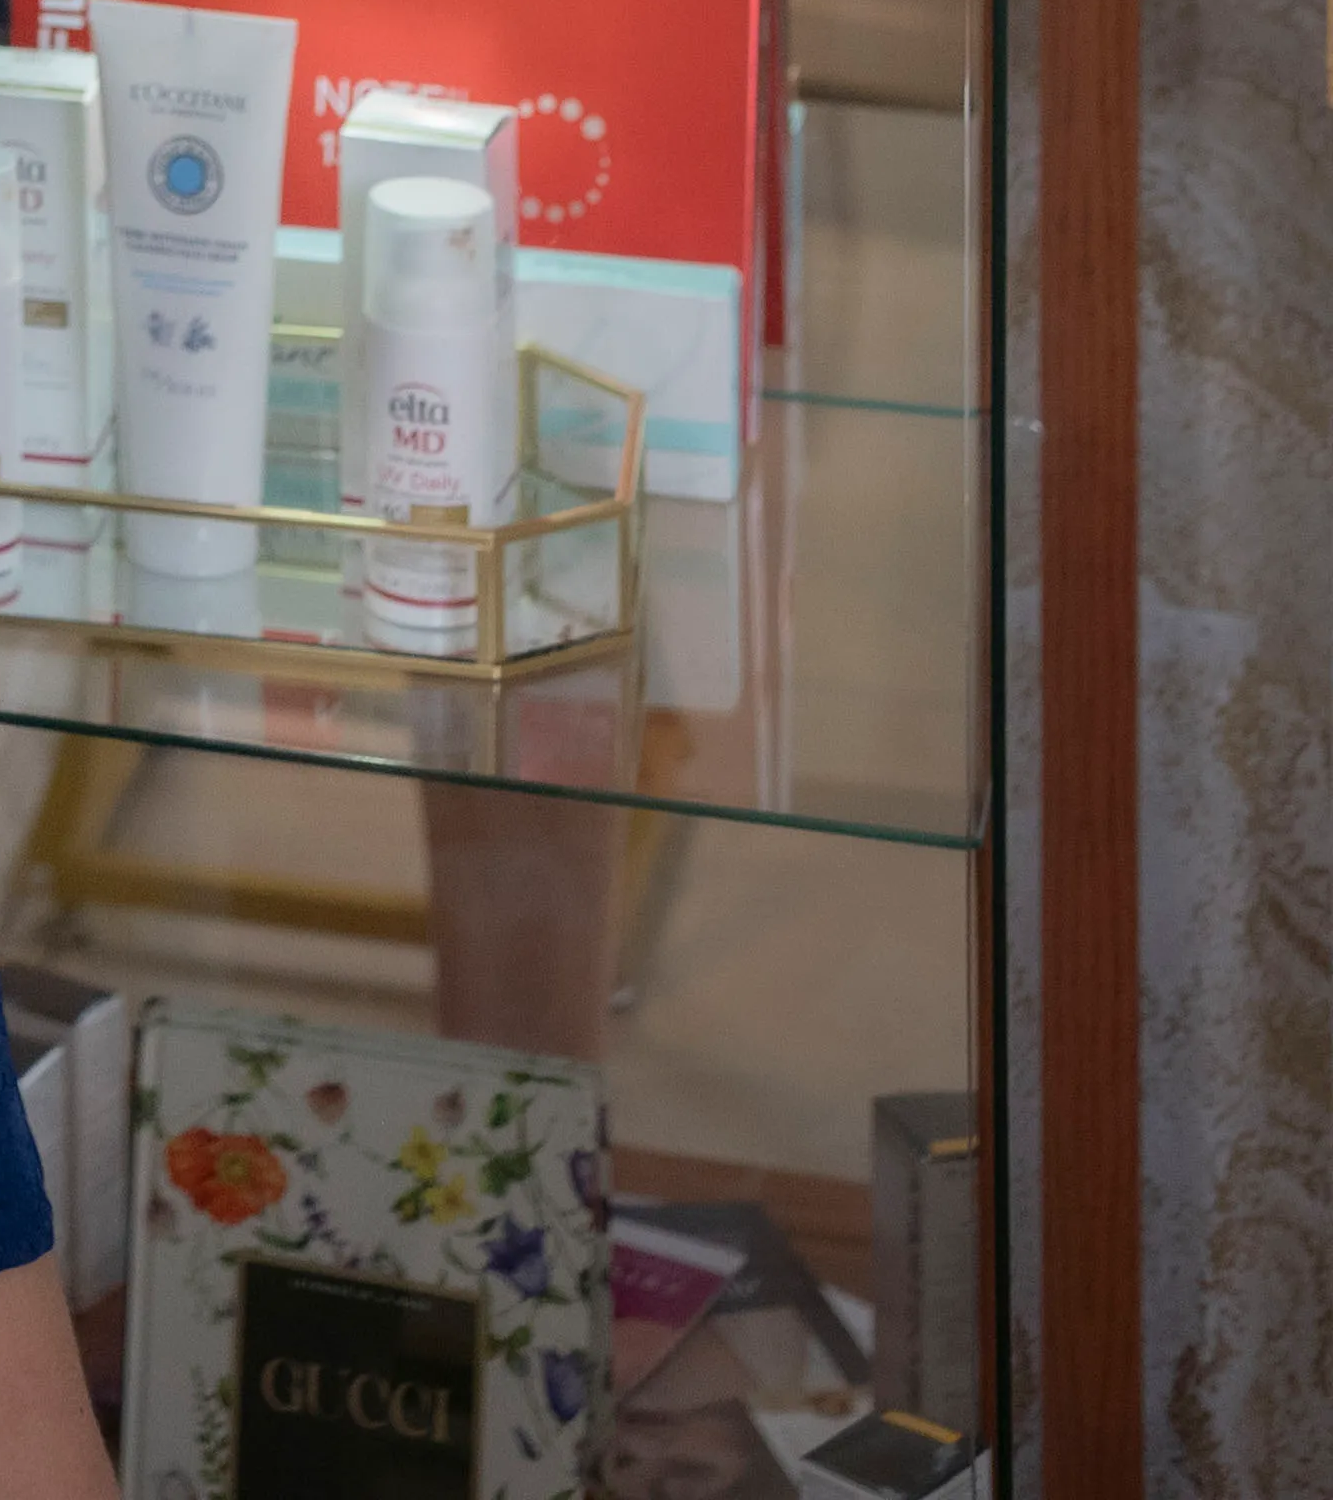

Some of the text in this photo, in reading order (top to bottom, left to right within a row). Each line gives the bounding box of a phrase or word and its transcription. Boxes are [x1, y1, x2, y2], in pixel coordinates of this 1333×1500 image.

[388, 392, 451, 426] elta
[393, 425, 447, 455] MD
[260, 1357, 452, 1444] GUCCI
